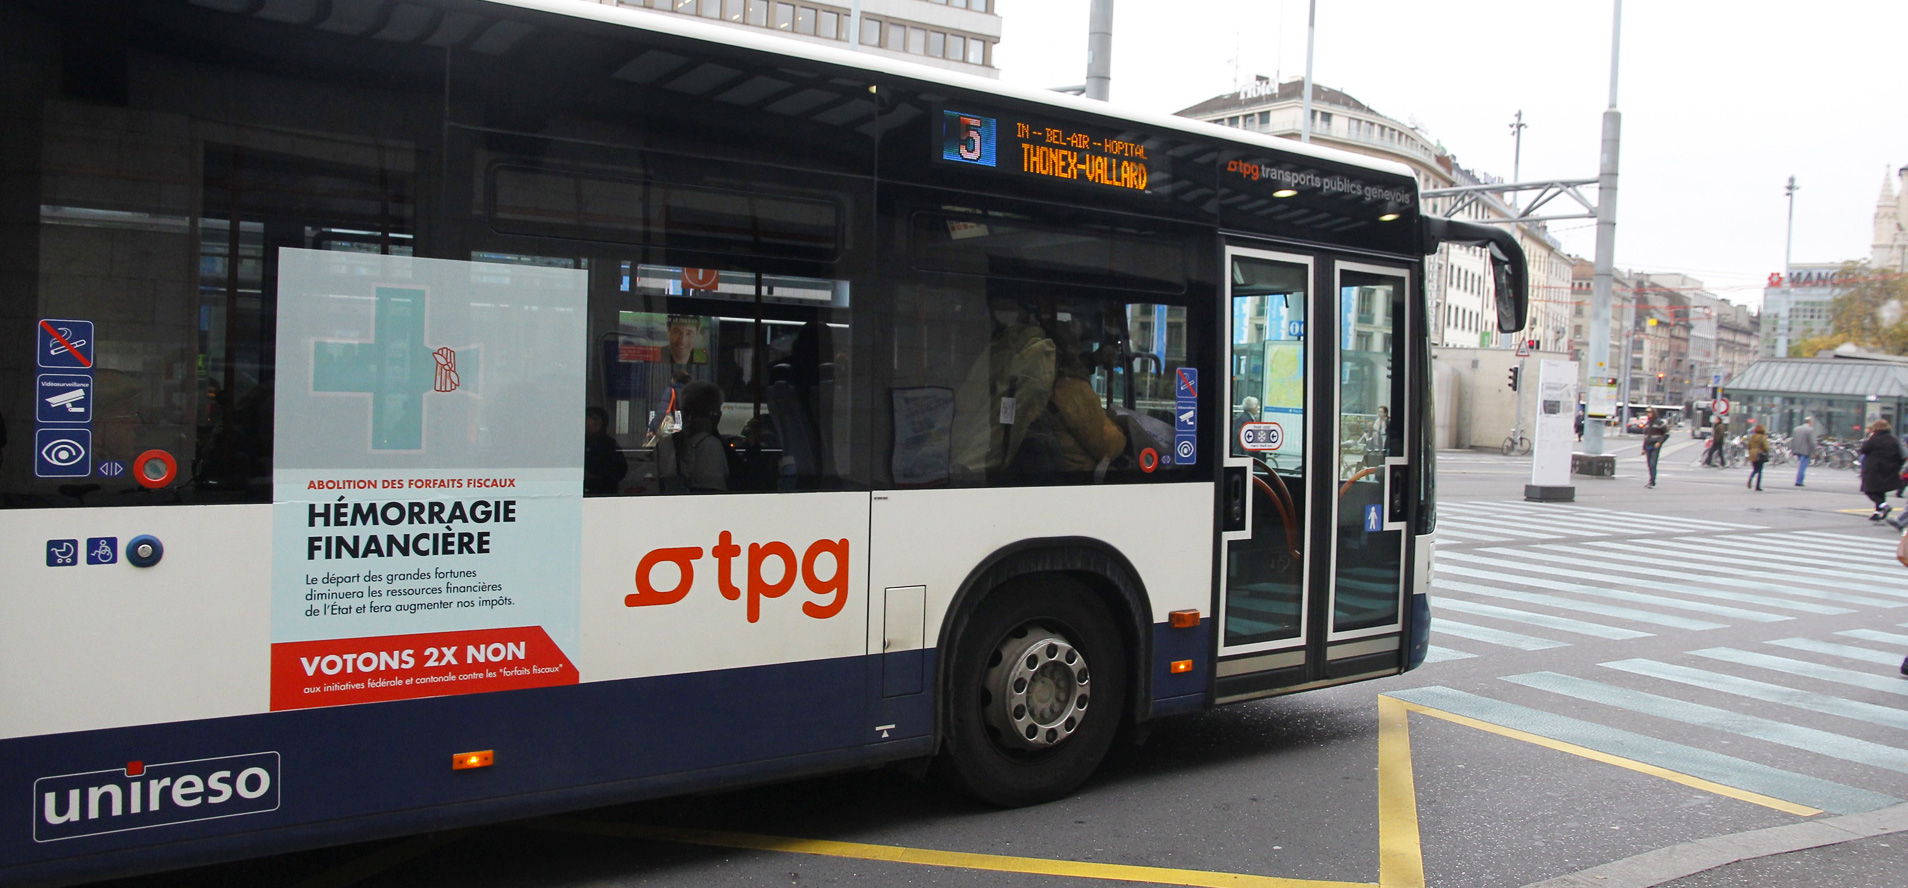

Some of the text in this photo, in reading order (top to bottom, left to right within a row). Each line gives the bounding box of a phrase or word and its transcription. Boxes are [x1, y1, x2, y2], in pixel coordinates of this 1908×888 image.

[959, 116, 982, 162] 5
[1017, 123, 1030, 138] IN
[1045, 128, 1090, 150] BEL-AIR
[1104, 139, 1148, 160] HOPITAL
[1022, 143, 1148, 190] THONEX-VALLARD
[1239, 160, 1410, 205] tpg transports publics genevois
[307, 478, 516, 490] ABOLITION DES FORFAITS FISCAUX
[308, 495, 516, 527] HÉMORRAGIE
[307, 525, 490, 560] FINANCIÈRE
[305, 567, 477, 587] Le départ des grandes fortunes
[305, 581, 502, 601] diminuera les ressources financières
[712, 530, 849, 623] tpg
[305, 604, 320, 617] de
[355, 604, 366, 613] et
[369, 600, 392, 612] fera
[395, 600, 453, 614] augmenter
[456, 600, 475, 608] nos
[478, 596, 515, 609] impôts.
[300, 641, 526, 677] VOTONS 2X NON
[303, 686, 321, 694] aux
[323, 681, 365, 692] initiatives
[368, 676, 403, 688] fédérale
[405, 677, 413, 685] et
[415, 672, 456, 684] cantonale
[458, 671, 484, 681] contre
[486, 668, 497, 678] les
[44, 761, 270, 824] unireso
